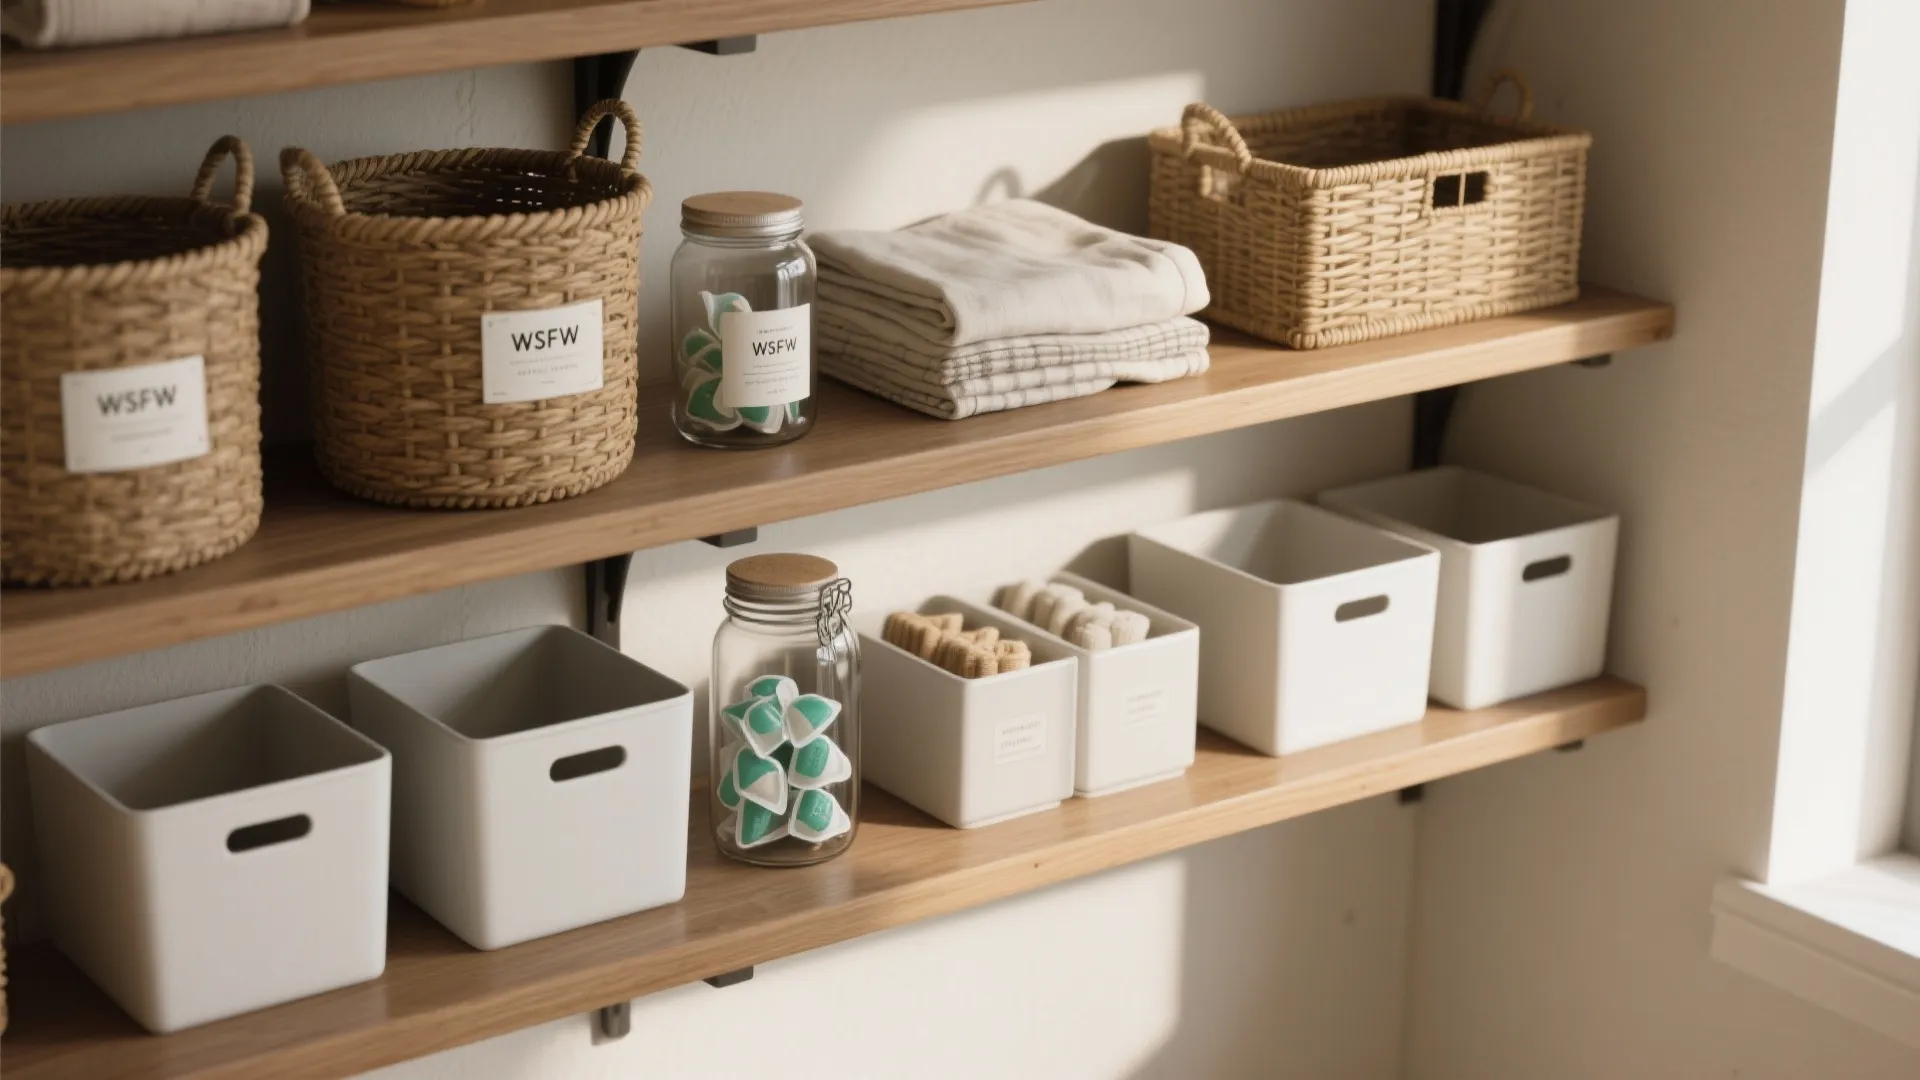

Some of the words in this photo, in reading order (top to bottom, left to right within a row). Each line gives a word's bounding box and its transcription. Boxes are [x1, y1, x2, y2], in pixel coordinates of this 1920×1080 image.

[511, 324, 579, 352] WSFW
[752, 338, 797, 356] WSFW
[97, 384, 176, 417] WSFW
